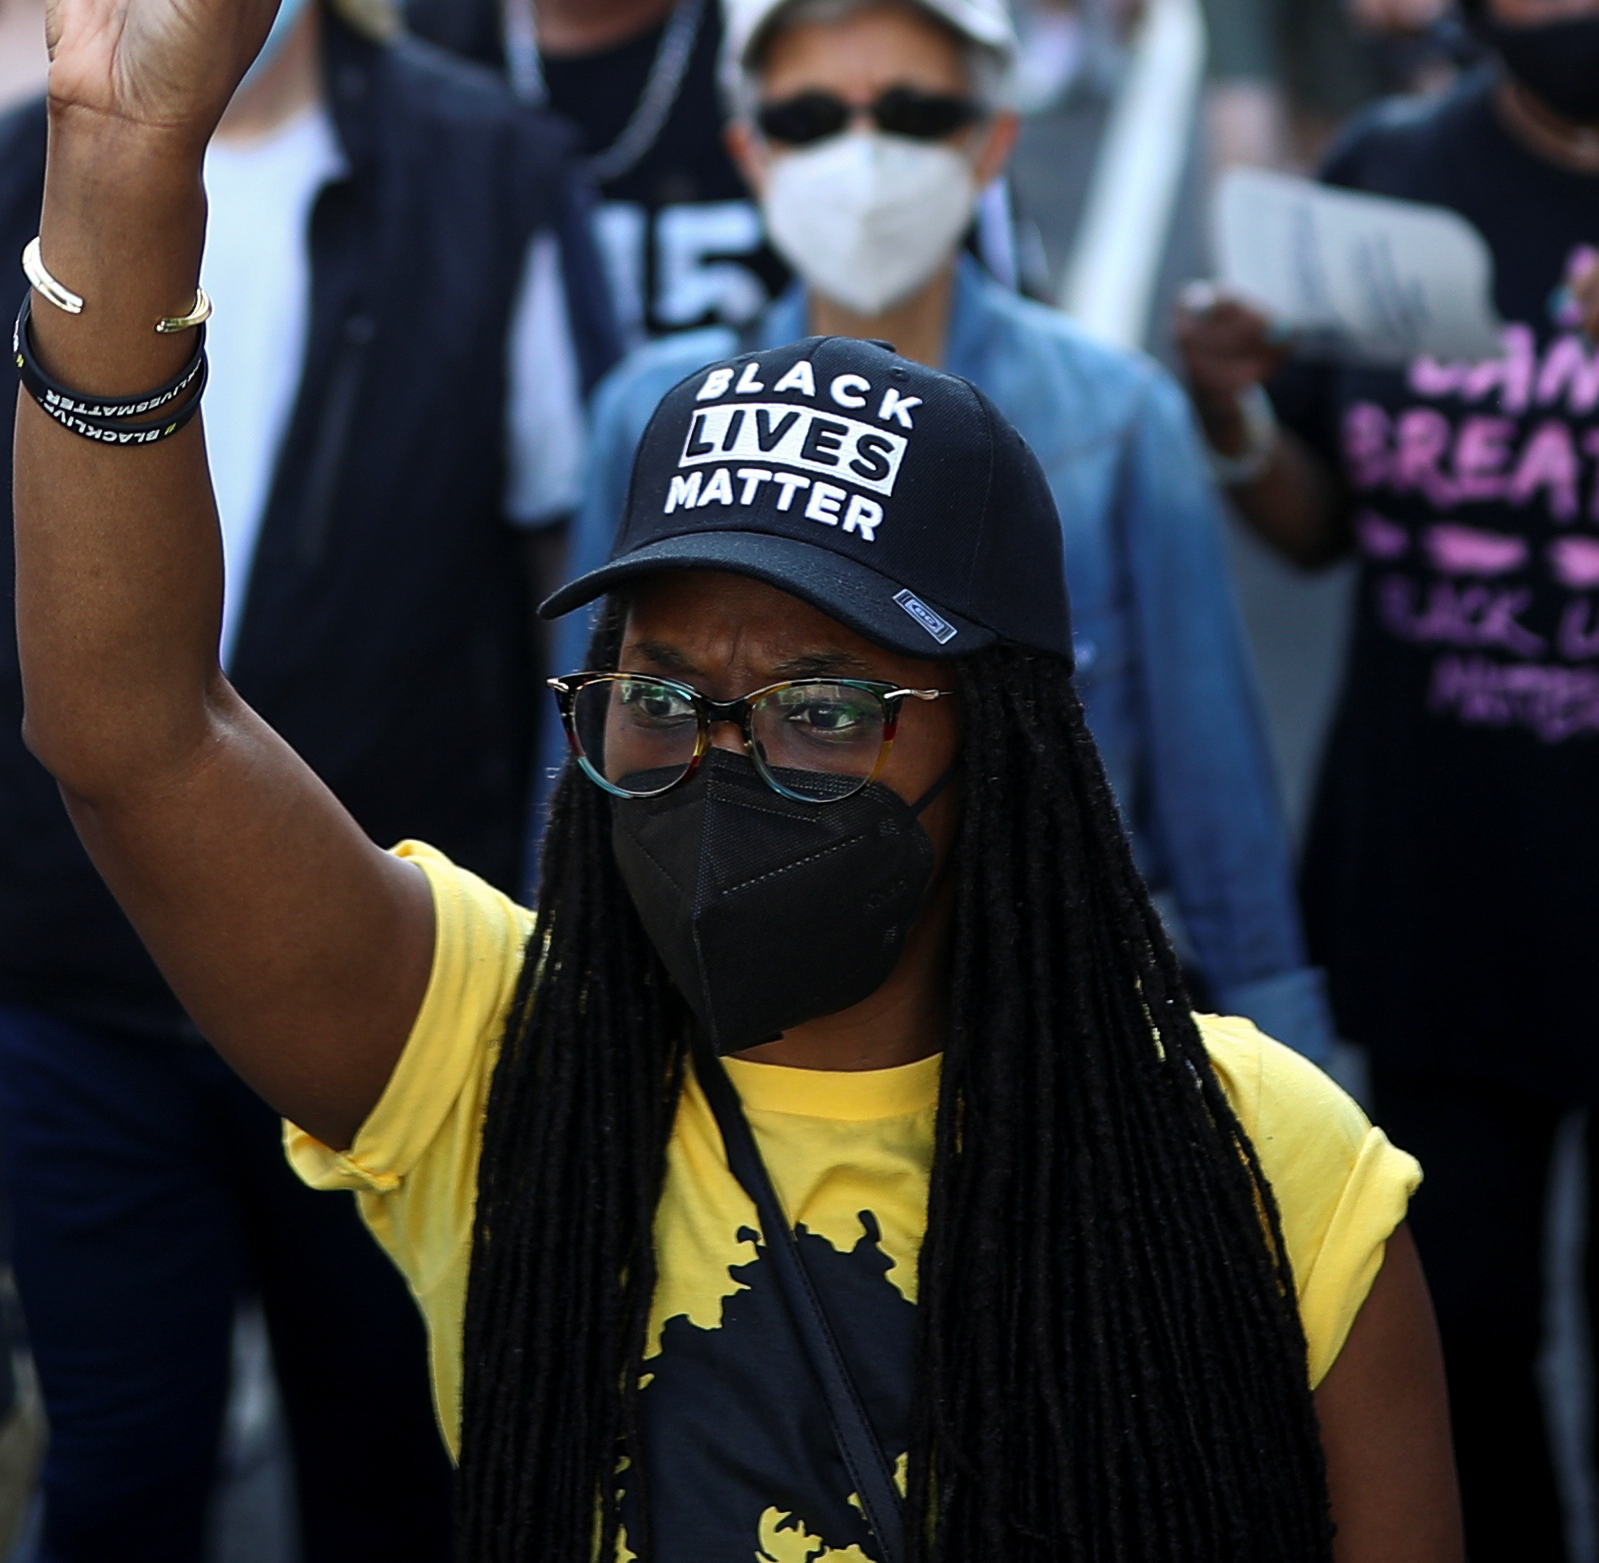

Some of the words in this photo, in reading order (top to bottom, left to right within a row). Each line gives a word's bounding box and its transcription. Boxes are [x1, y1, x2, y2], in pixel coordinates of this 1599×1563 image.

[696, 361, 923, 430] BLACK
[685, 409, 896, 482] LIVES
[664, 467, 885, 541] MATTER
